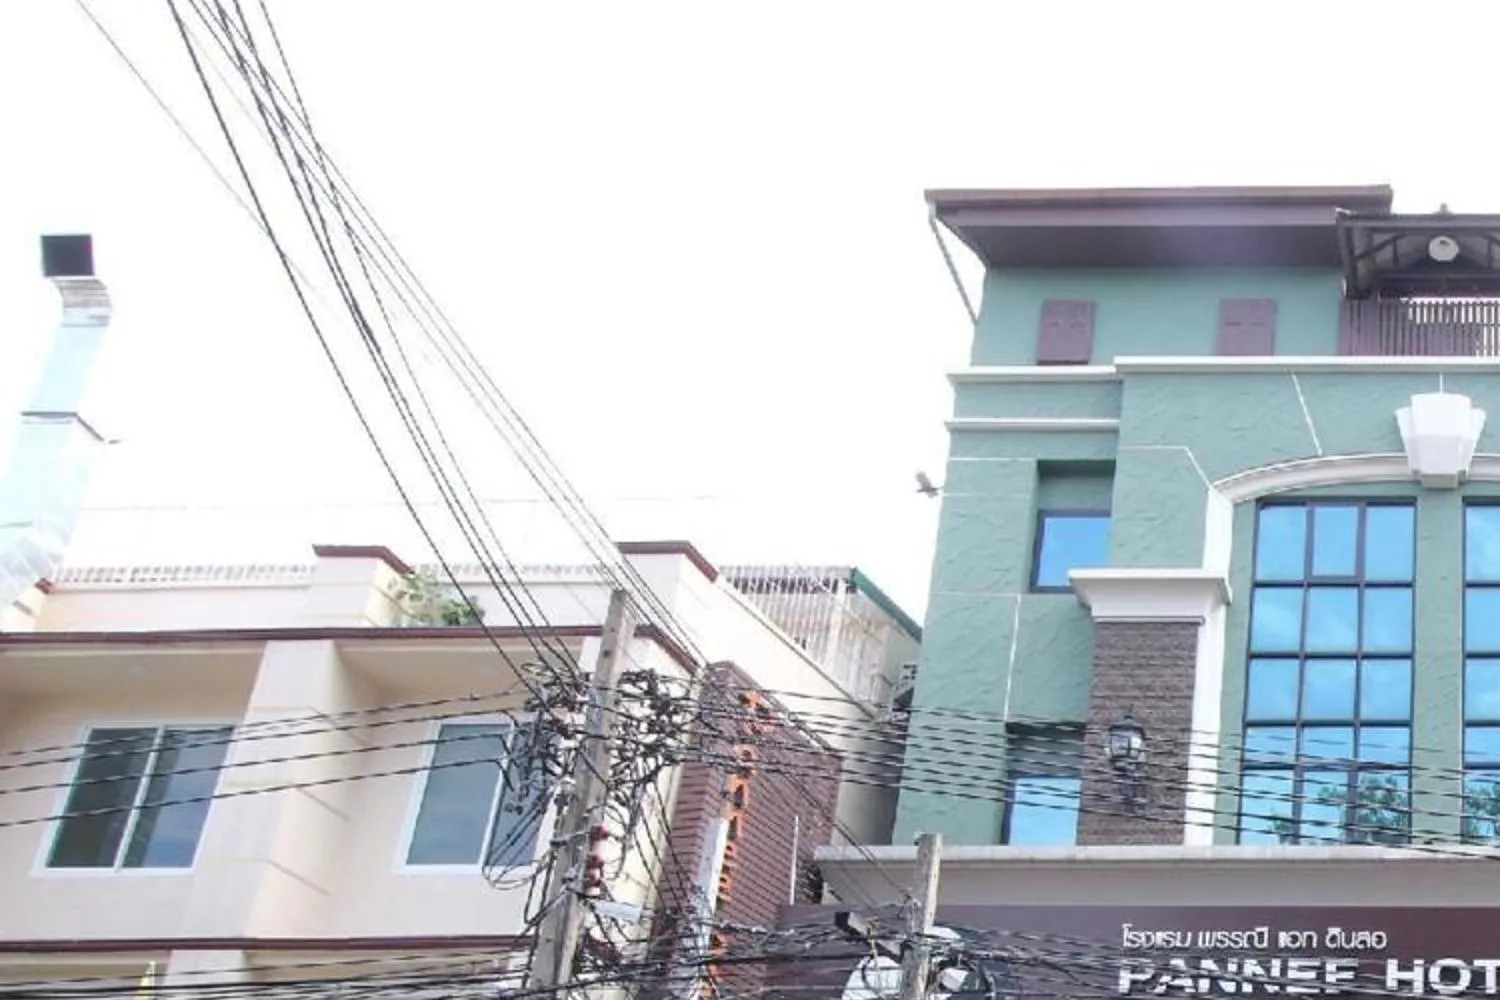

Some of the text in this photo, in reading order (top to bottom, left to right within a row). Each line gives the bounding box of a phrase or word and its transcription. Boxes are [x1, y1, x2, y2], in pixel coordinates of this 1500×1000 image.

[1122, 923, 1192, 949] โรงแรม
[1198, 926, 1269, 949] พรรณี
[1325, 926, 1388, 949] ดินสอ
